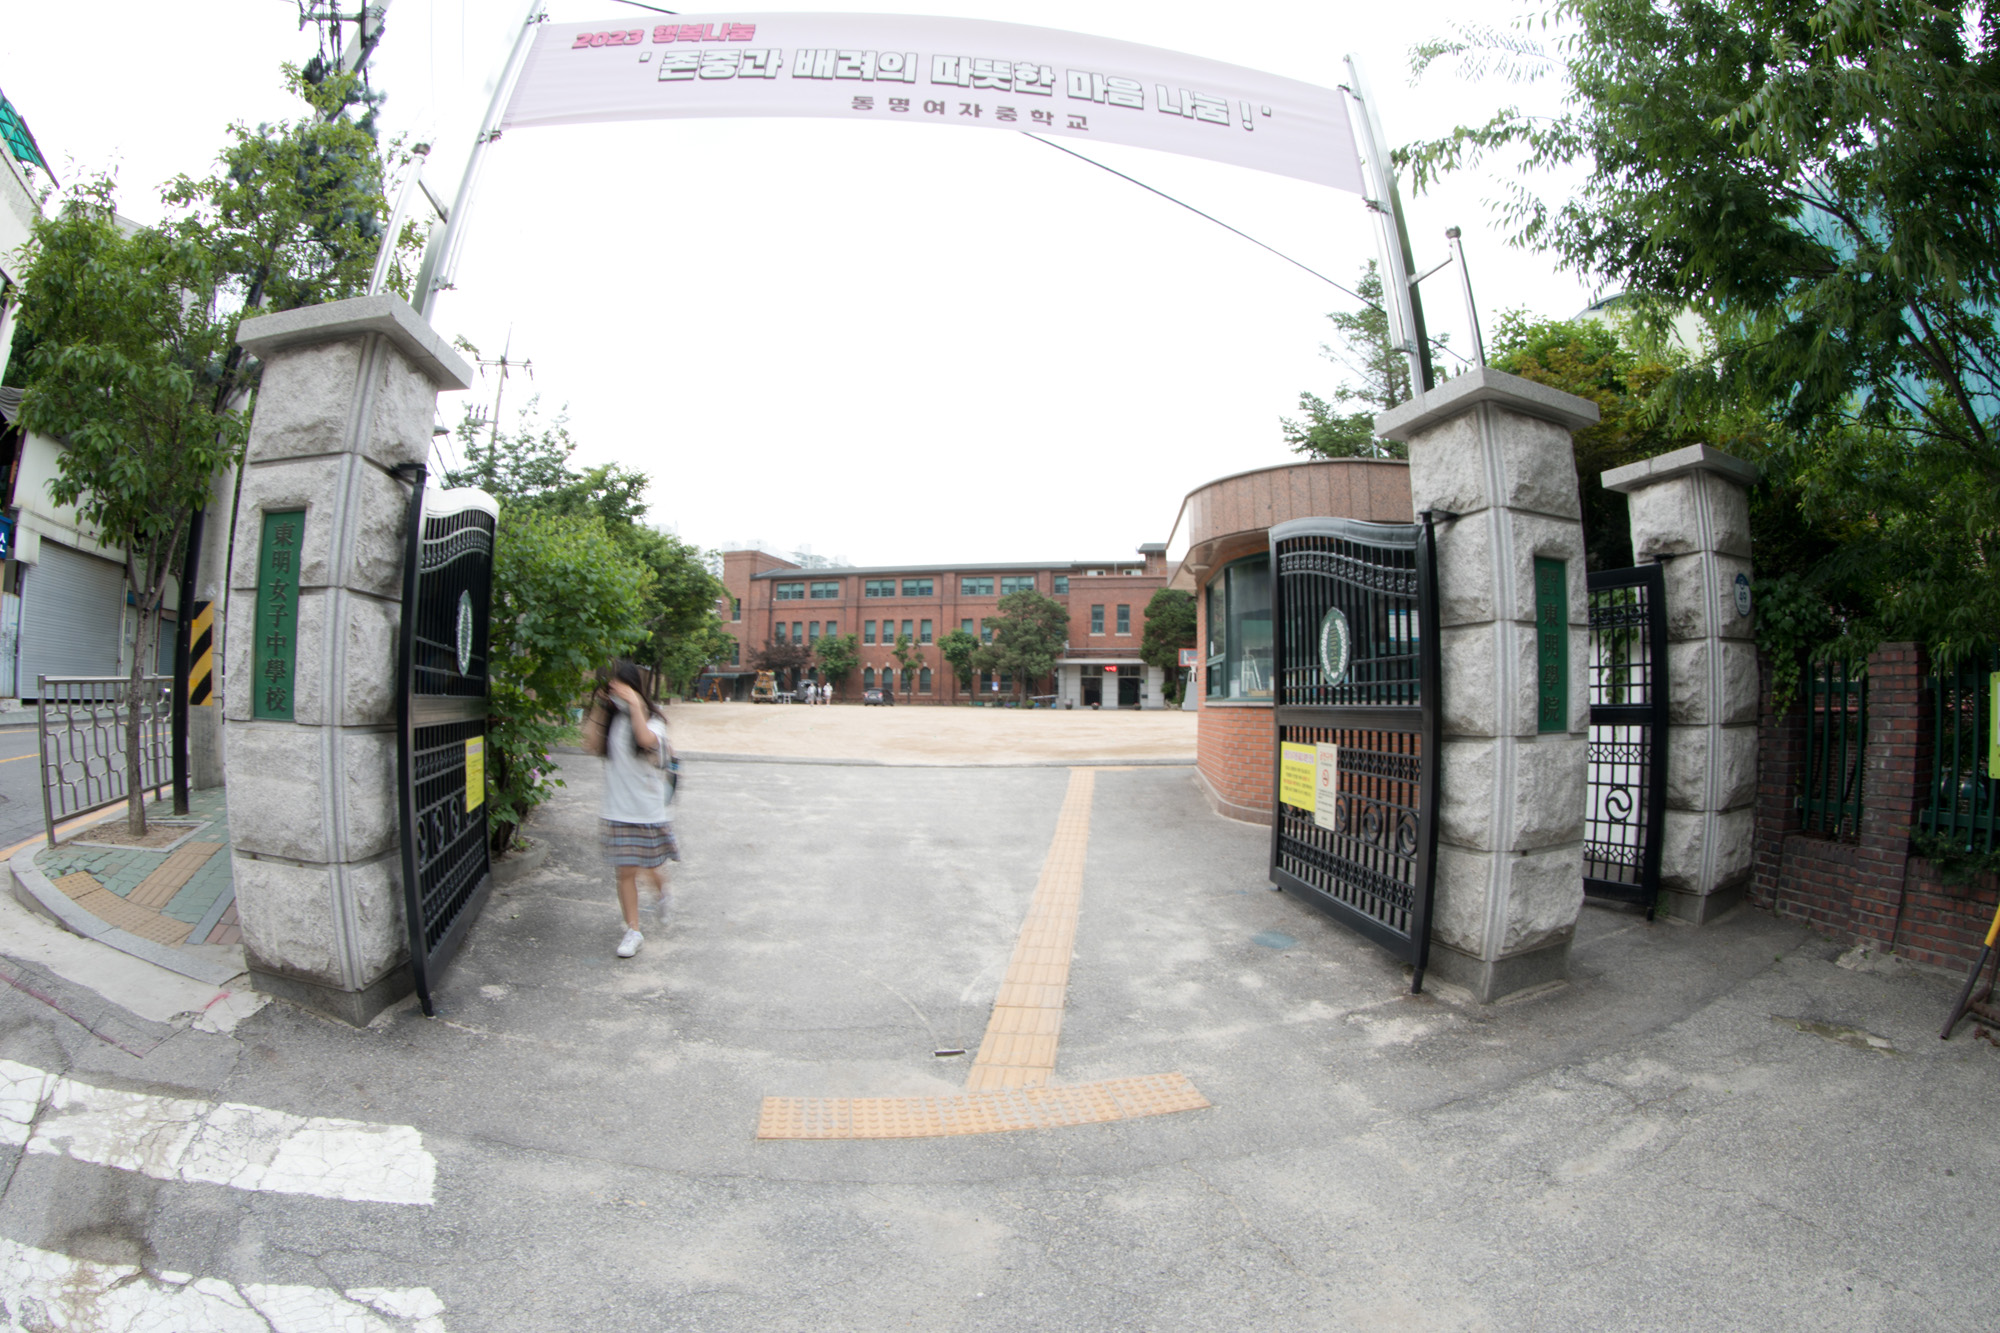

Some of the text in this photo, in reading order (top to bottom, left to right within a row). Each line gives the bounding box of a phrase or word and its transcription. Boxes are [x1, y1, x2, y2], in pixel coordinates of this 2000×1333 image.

[571, 23, 757, 49] 2023 행복나눔
[792, 48, 918, 84] 배려의
[931, 54, 1056, 96] 따뜻한
[1066, 68, 1144, 111] 마음
[851, 95, 1089, 131] 동명여자중학교
[264, 520, 296, 713] 東明女子中學校
